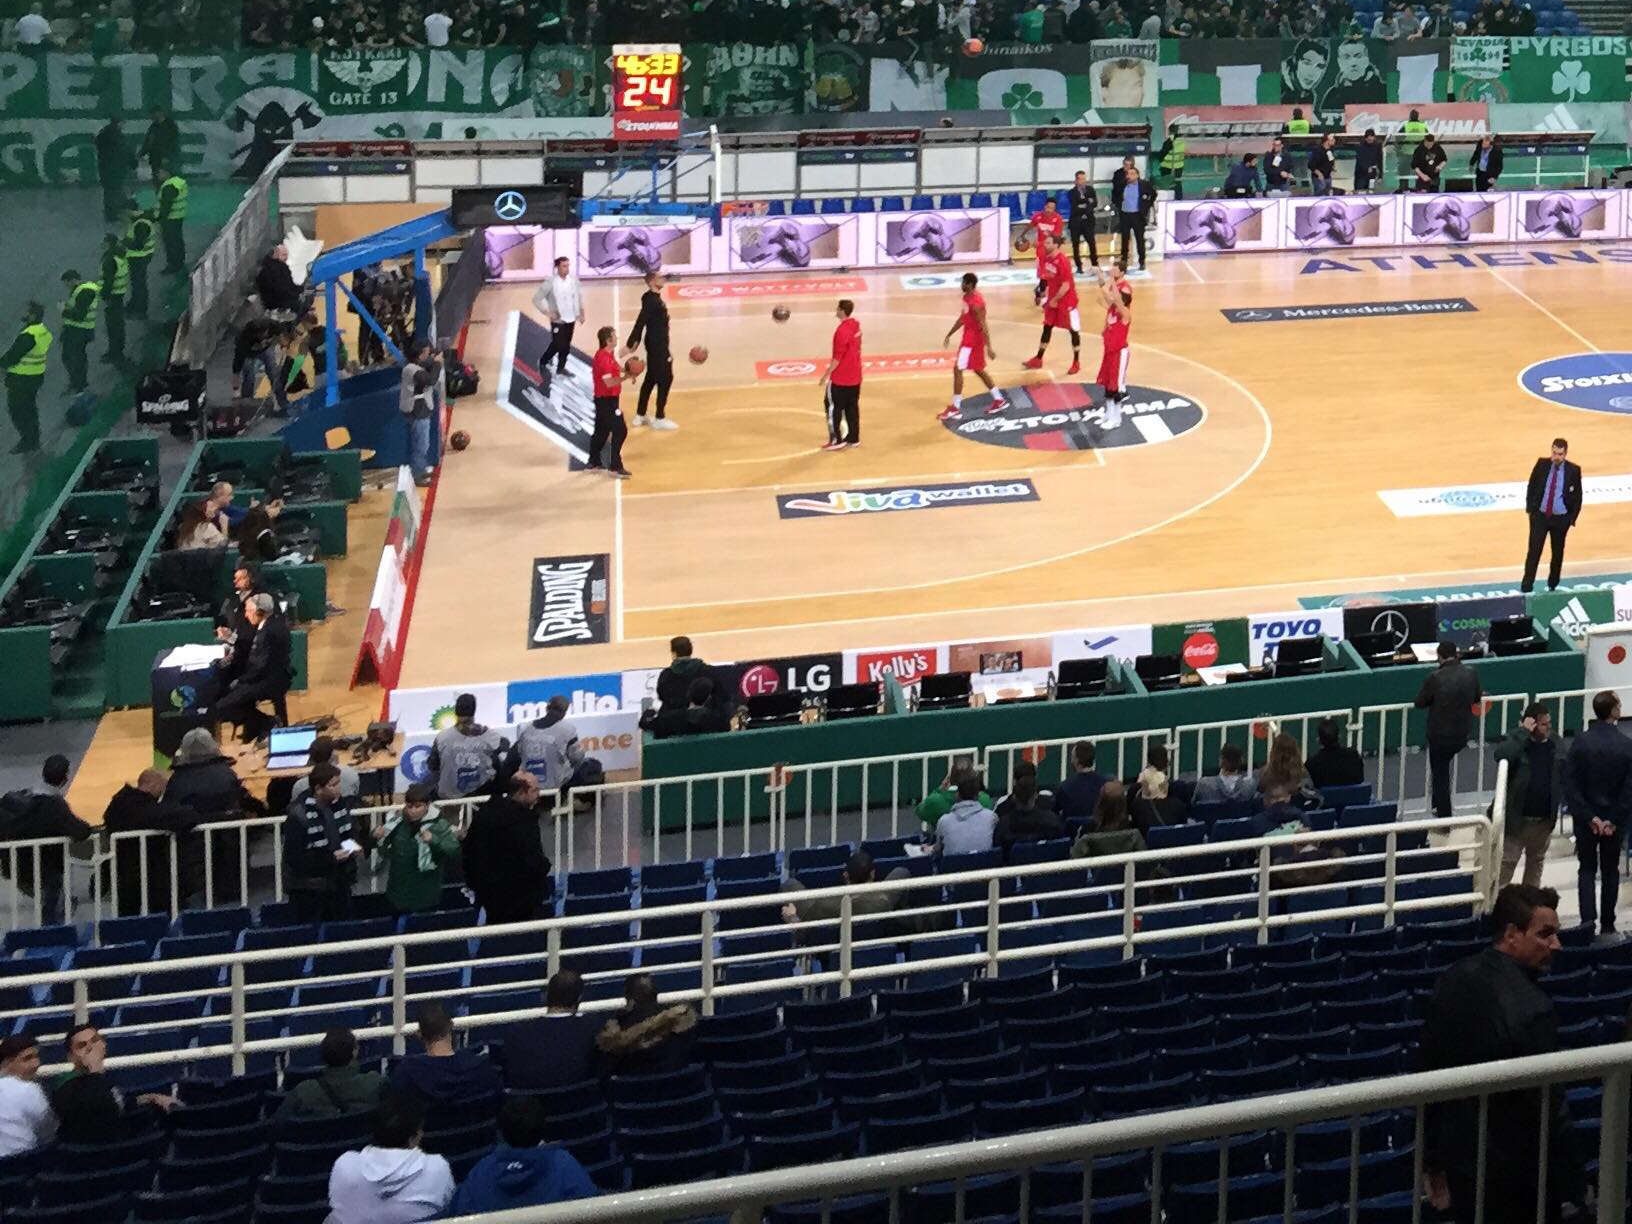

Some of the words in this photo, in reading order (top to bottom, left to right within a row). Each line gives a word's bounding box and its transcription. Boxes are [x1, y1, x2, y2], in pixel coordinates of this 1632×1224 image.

[1511, 37, 1627, 57] PYRGOS
[622, 77, 672, 107] 24
[1282, 299, 1465, 320] Mercedes-Benz
[533, 560, 594, 642] SPALDING
[1251, 618, 1323, 641] TOYO
[787, 663, 832, 693] LG
[869, 650, 930, 683] Kelly's
